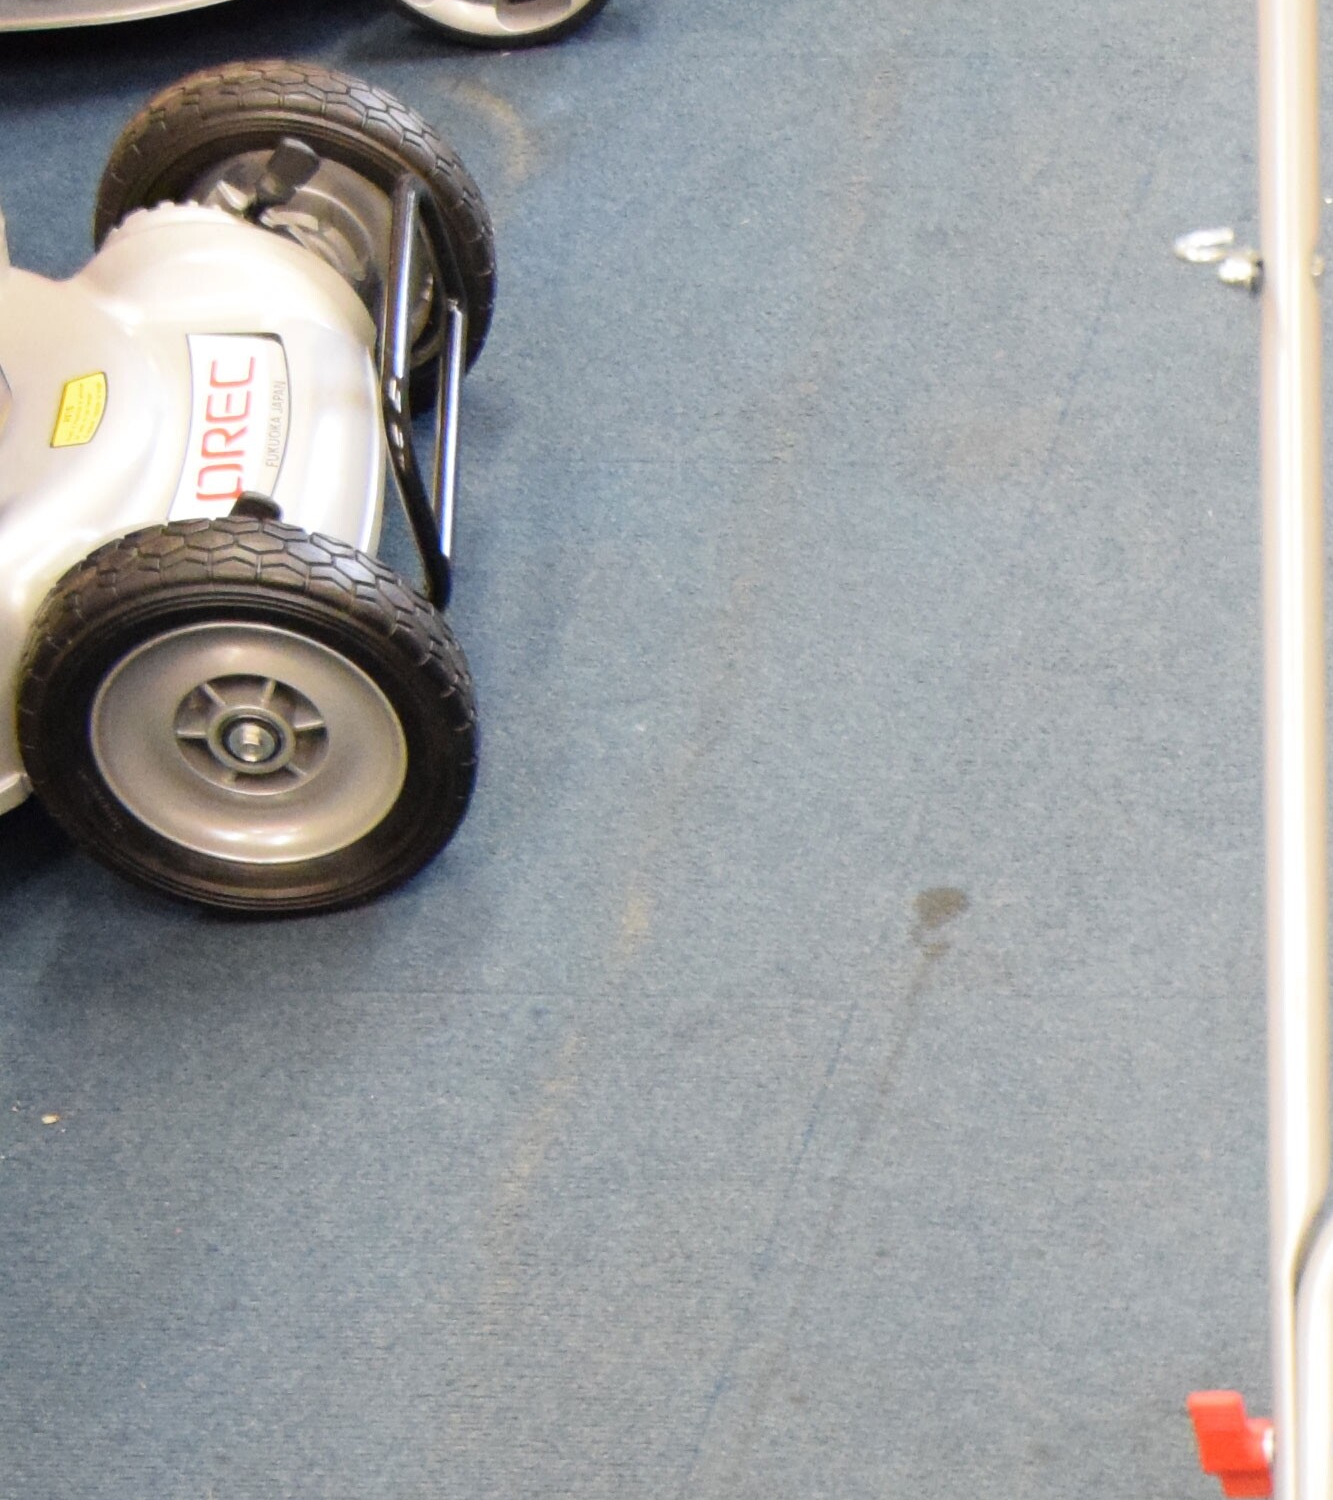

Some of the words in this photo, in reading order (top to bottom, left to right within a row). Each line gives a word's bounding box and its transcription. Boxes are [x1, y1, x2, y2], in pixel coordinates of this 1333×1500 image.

[272, 380, 287, 415] JAPAN
[196, 356, 255, 502] OREC
[266, 417, 281, 468] FUKUOKA
